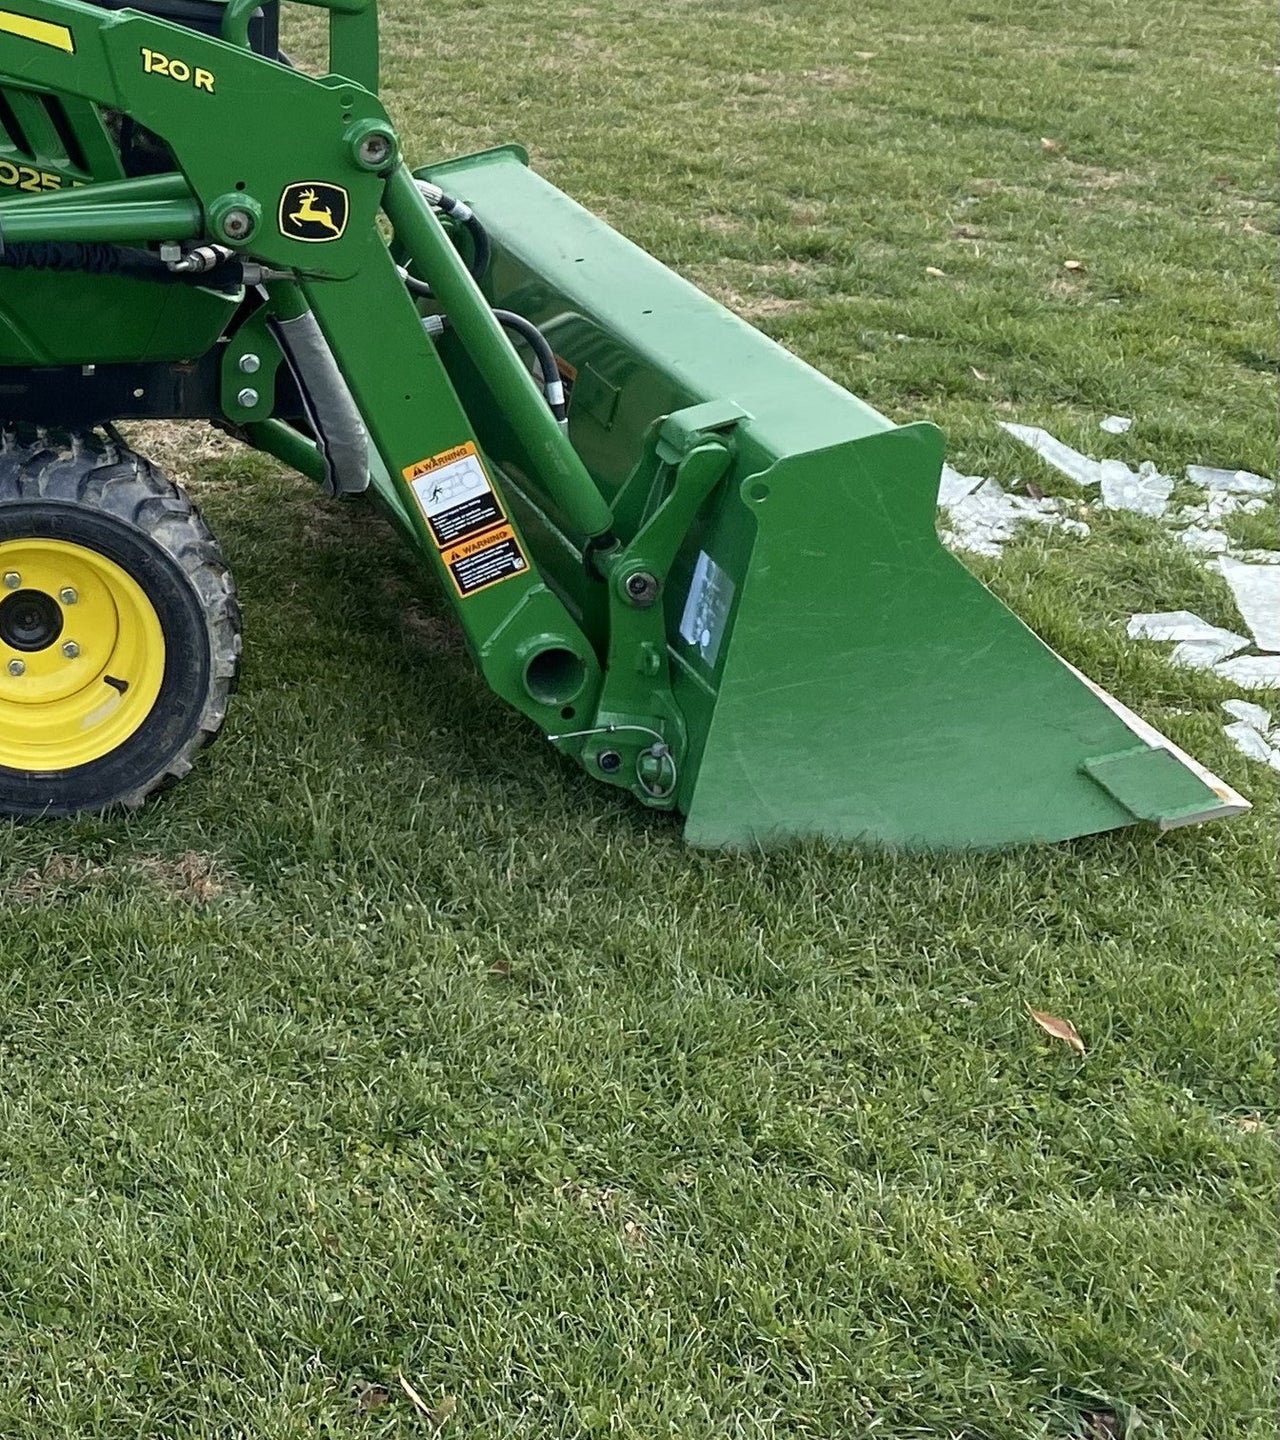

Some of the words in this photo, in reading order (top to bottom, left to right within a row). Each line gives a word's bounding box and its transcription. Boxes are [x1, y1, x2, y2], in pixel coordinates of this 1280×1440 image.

[141, 47, 191, 82] 120
[195, 67, 215, 92] R
[423, 447, 468, 471] WARNING
[462, 530, 507, 554] WARNING
